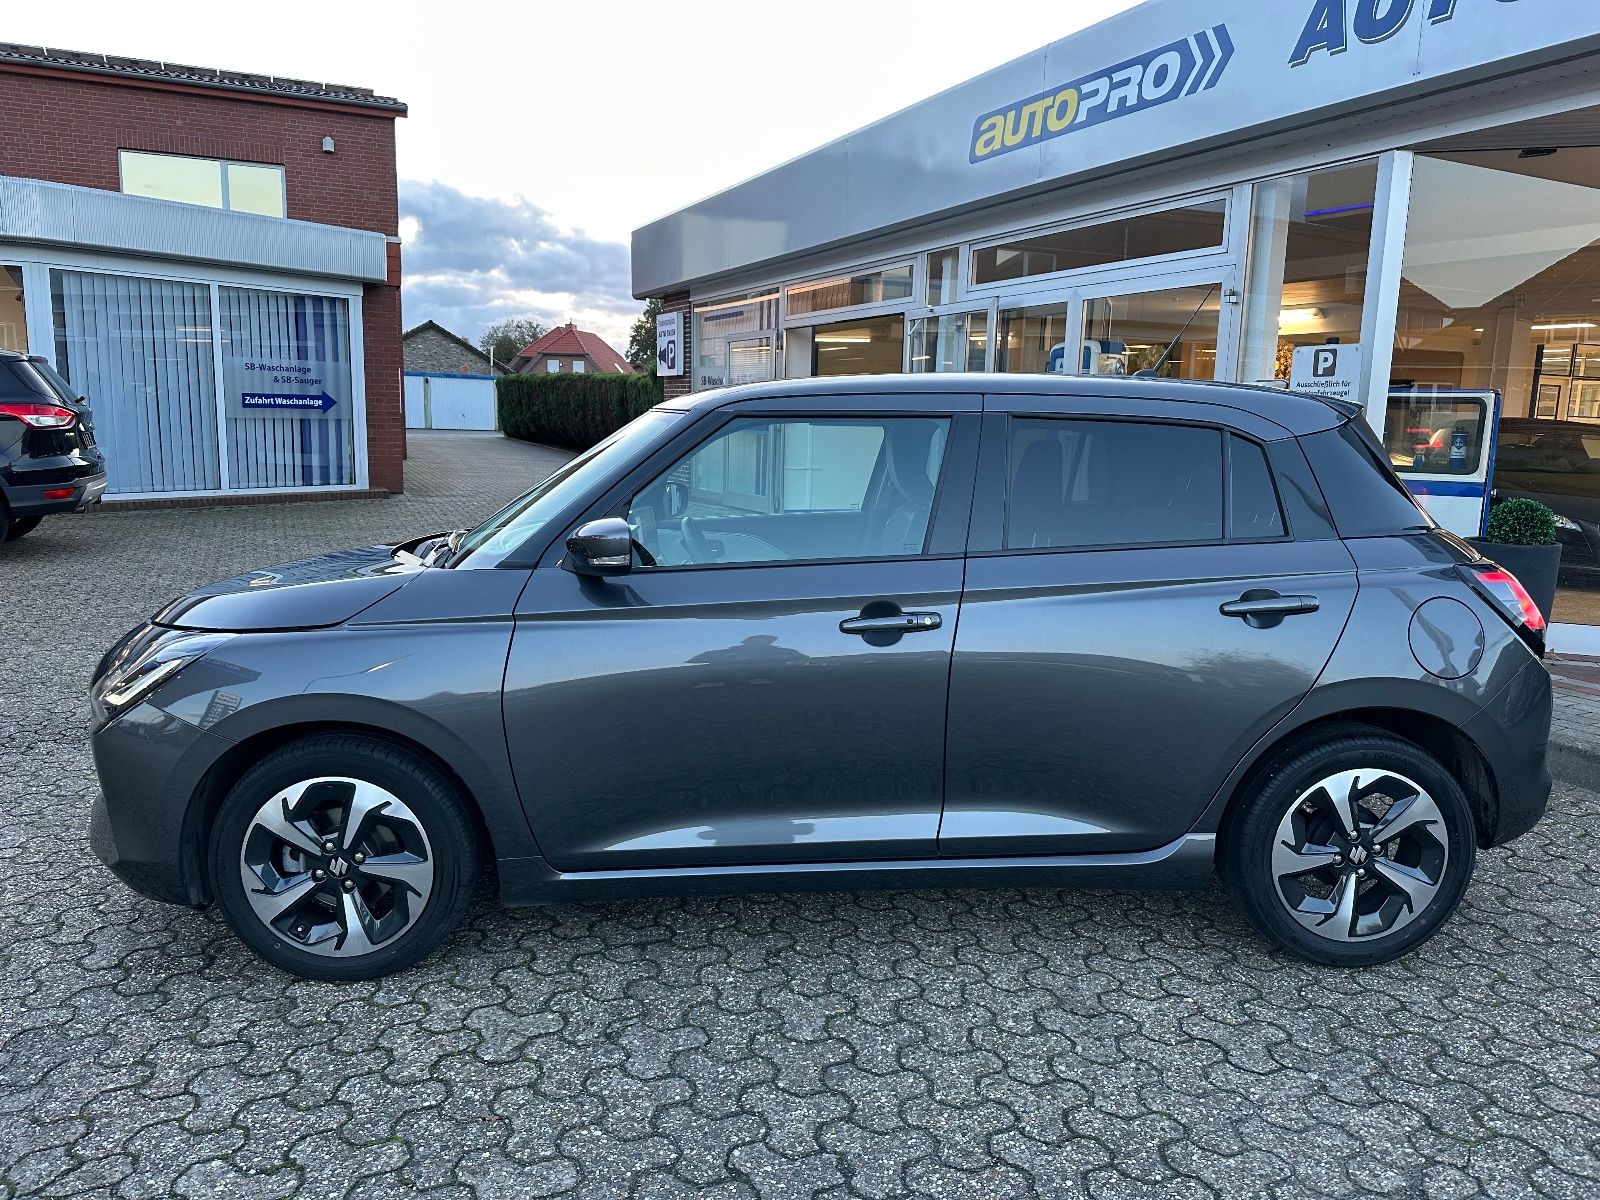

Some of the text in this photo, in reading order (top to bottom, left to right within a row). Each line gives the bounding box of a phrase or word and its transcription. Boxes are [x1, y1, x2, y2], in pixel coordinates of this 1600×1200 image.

[244, 362, 312, 374] SB-Waschanlage
[1317, 351, 1334, 375] P
[273, 375, 322, 386] & SB-Sauger
[244, 396, 323, 407] Zufahrt Waschanlage
